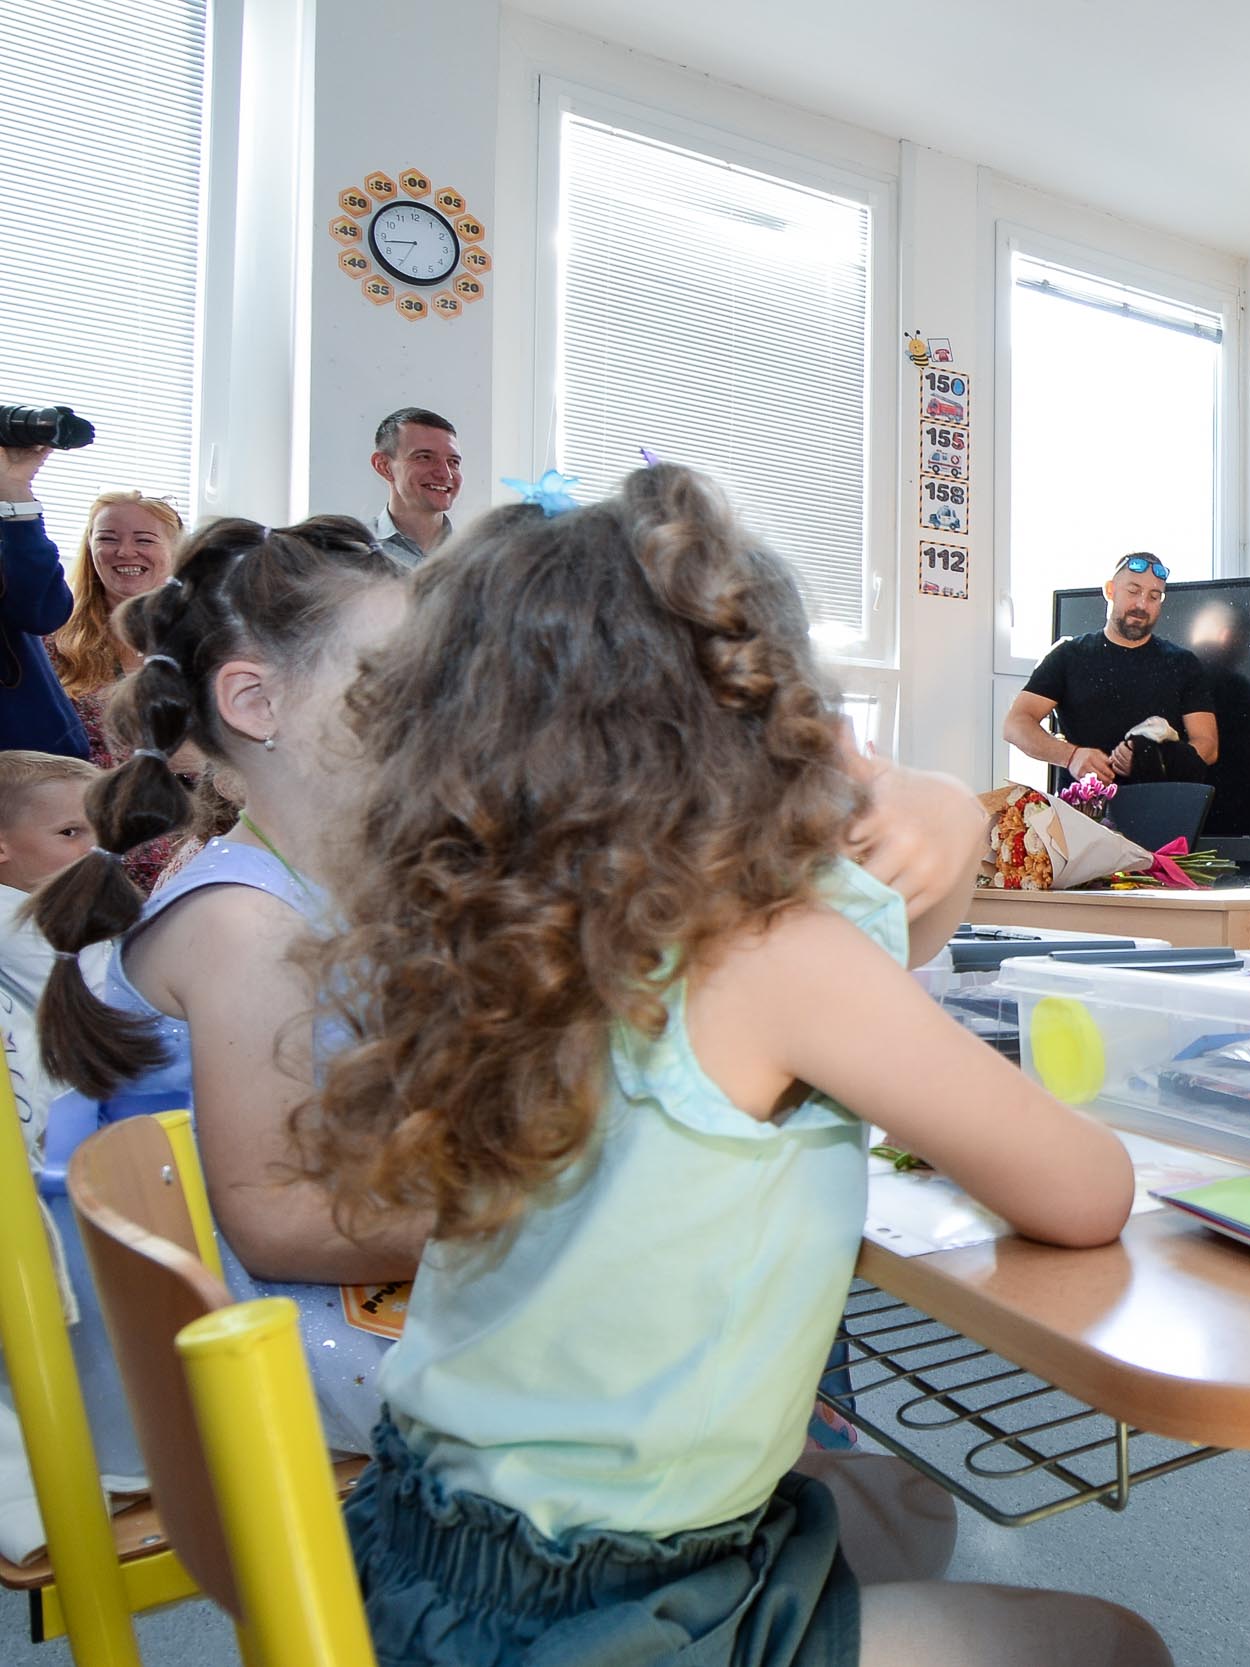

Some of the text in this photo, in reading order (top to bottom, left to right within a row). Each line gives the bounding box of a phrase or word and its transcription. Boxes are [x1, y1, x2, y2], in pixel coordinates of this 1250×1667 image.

[370, 180, 392, 192] :55
[404, 178, 426, 189] :00
[344, 196, 367, 208] :50
[440, 196, 462, 208] :05
[396, 214, 404, 222] 11
[411, 214, 420, 222] 12
[334, 226, 358, 237] :45
[386, 222, 396, 230] 10
[459, 223, 480, 234] :10
[381, 232, 386, 240] 9
[442, 246, 448, 254] 3
[344, 258, 367, 269] :40
[467, 254, 486, 266] :15
[368, 284, 390, 296] :35
[458, 282, 480, 294] :20
[400, 300, 422, 312] :30
[436, 299, 457, 310] :25
[925, 372, 965, 396] 150
[926, 428, 965, 450] 155
[925, 482, 964, 505] 158
[924, 547, 966, 572] 112
